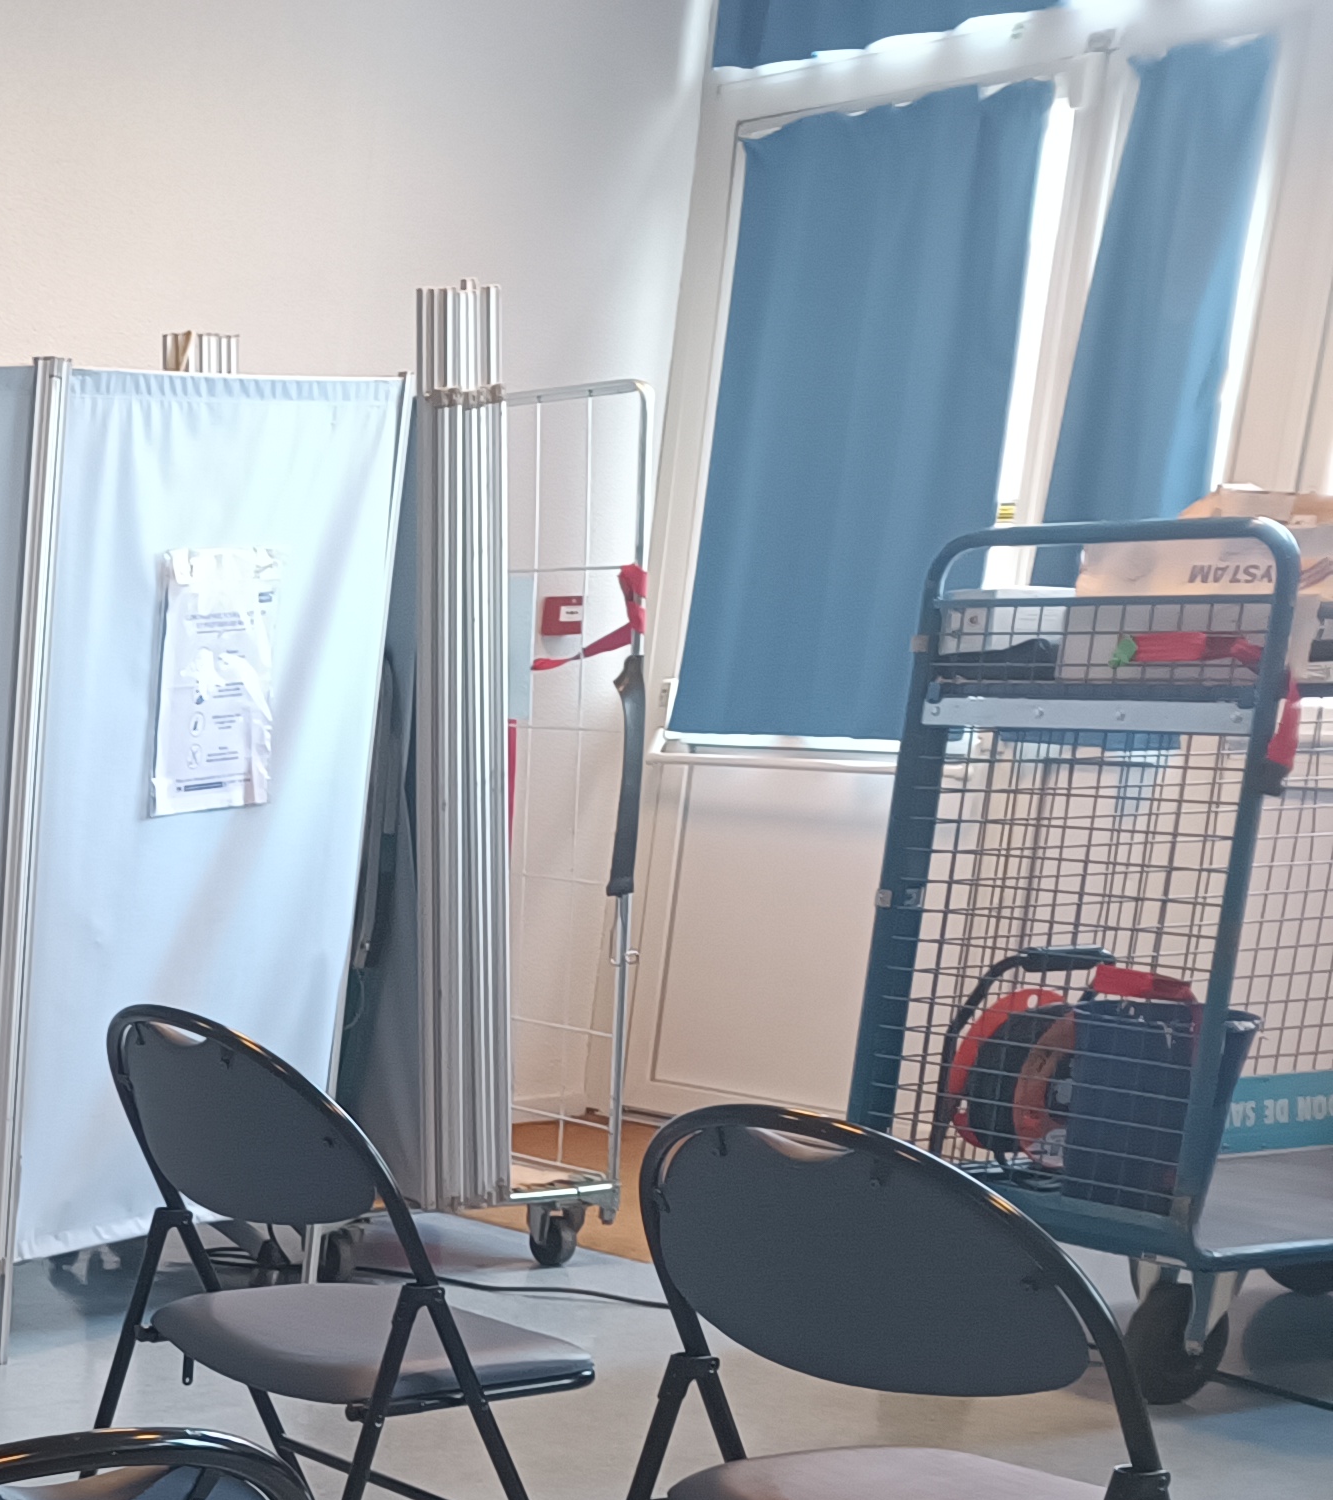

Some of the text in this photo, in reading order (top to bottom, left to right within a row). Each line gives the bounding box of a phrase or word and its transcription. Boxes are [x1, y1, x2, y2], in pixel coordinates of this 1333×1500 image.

[1188, 564, 1273, 583] YSTAM
[1225, 1102, 1255, 1129] SA
[1263, 1099, 1289, 1124] DE
